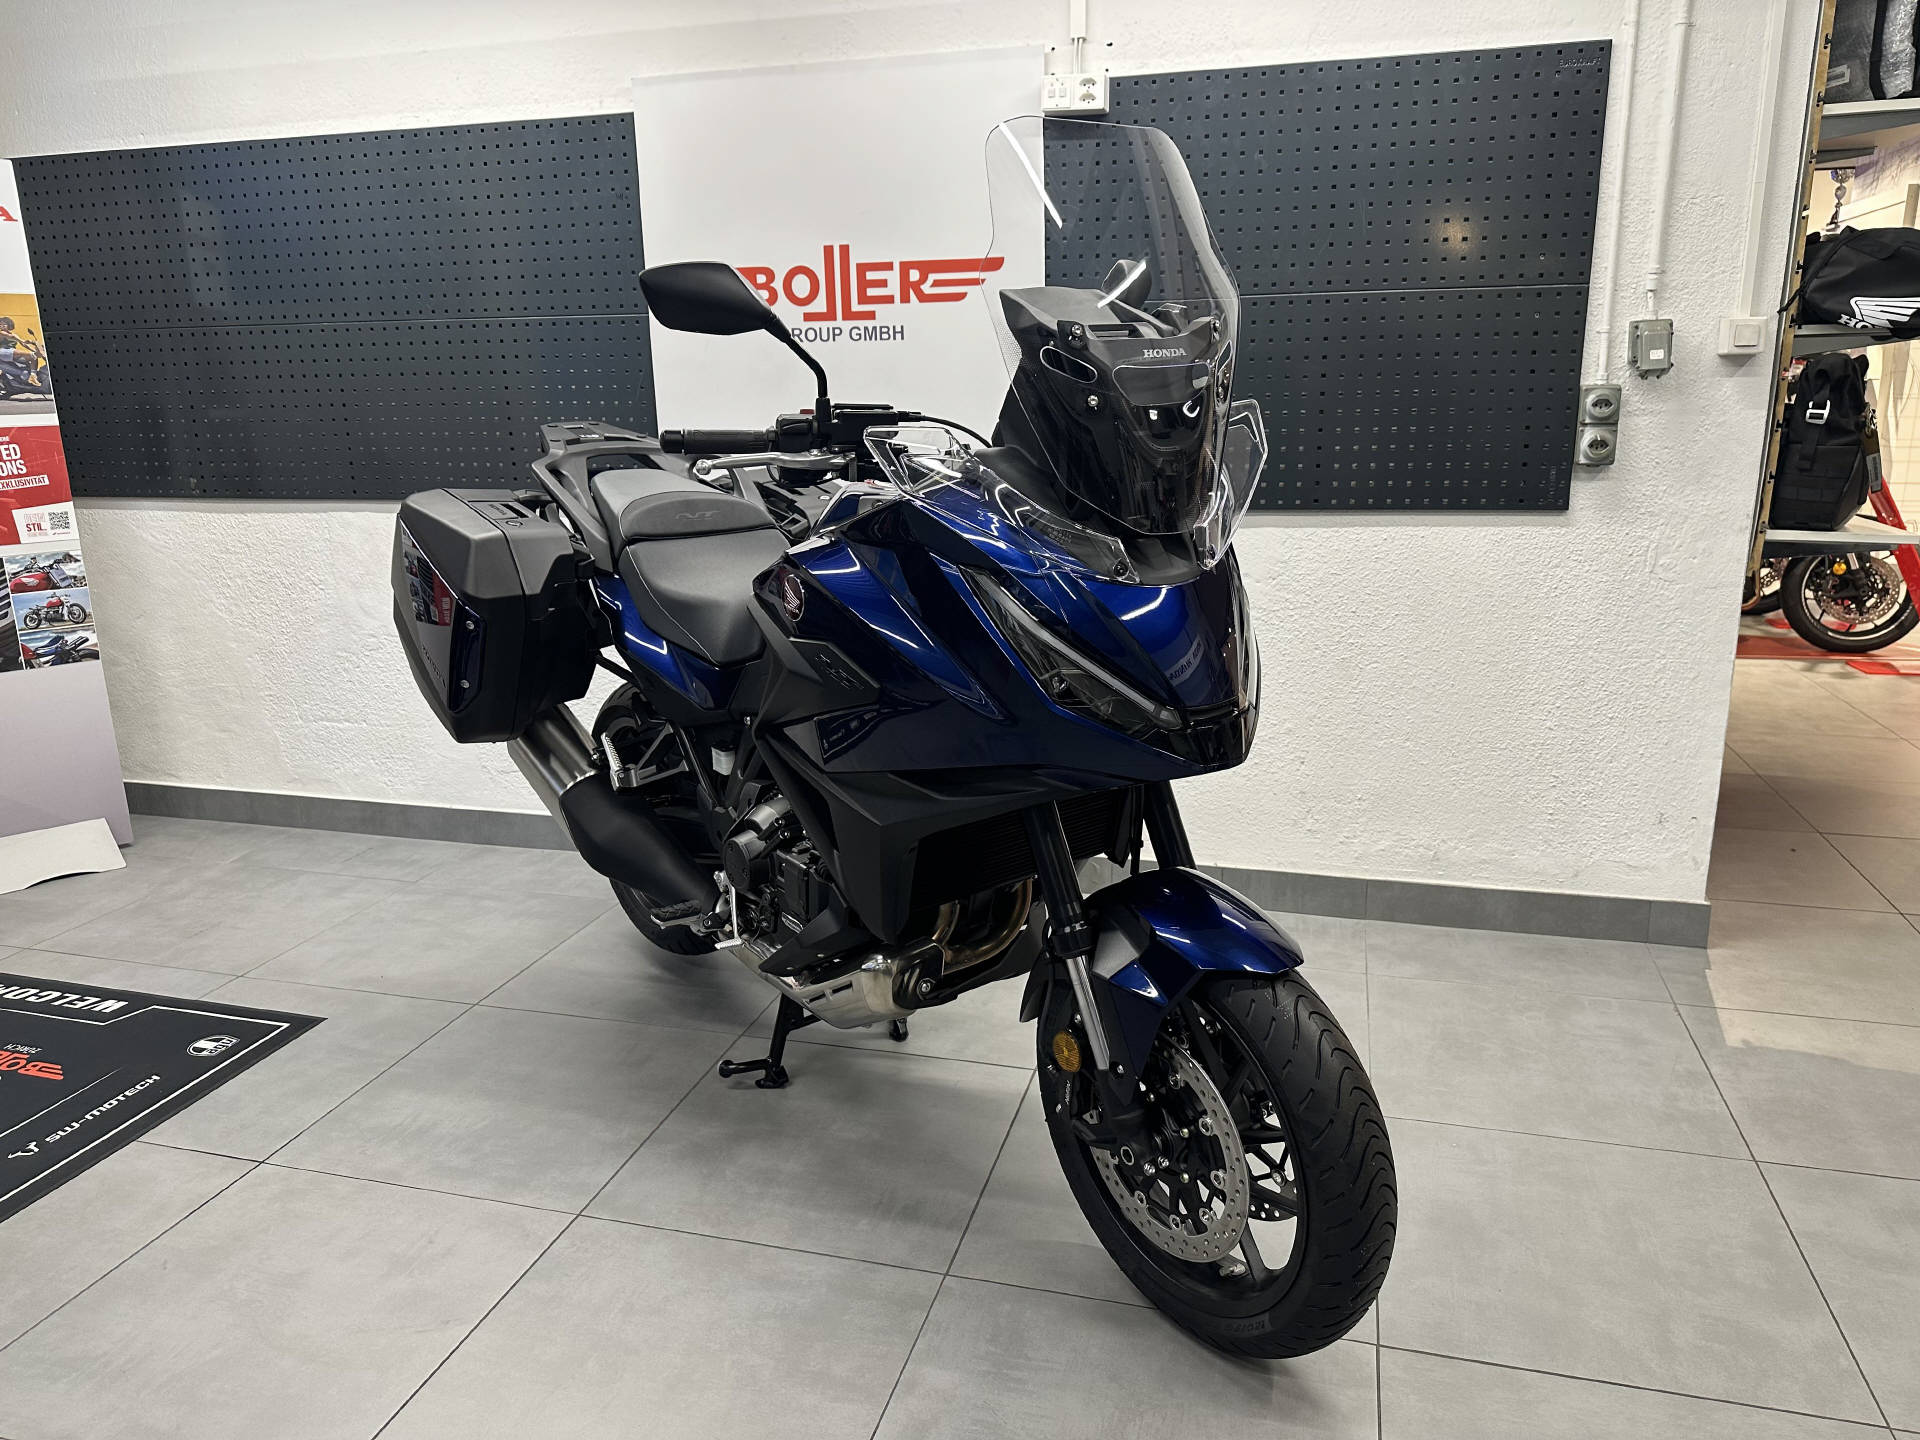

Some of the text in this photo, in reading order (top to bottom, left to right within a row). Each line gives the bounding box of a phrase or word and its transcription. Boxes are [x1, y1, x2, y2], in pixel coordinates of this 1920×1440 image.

[735, 244, 1004, 321] BOLLER
[791, 325, 905, 342] ROUP GMBH
[1142, 347, 1188, 358] HONDA
[0, 444, 21, 460] ED
[0, 460, 27, 477] ONS
